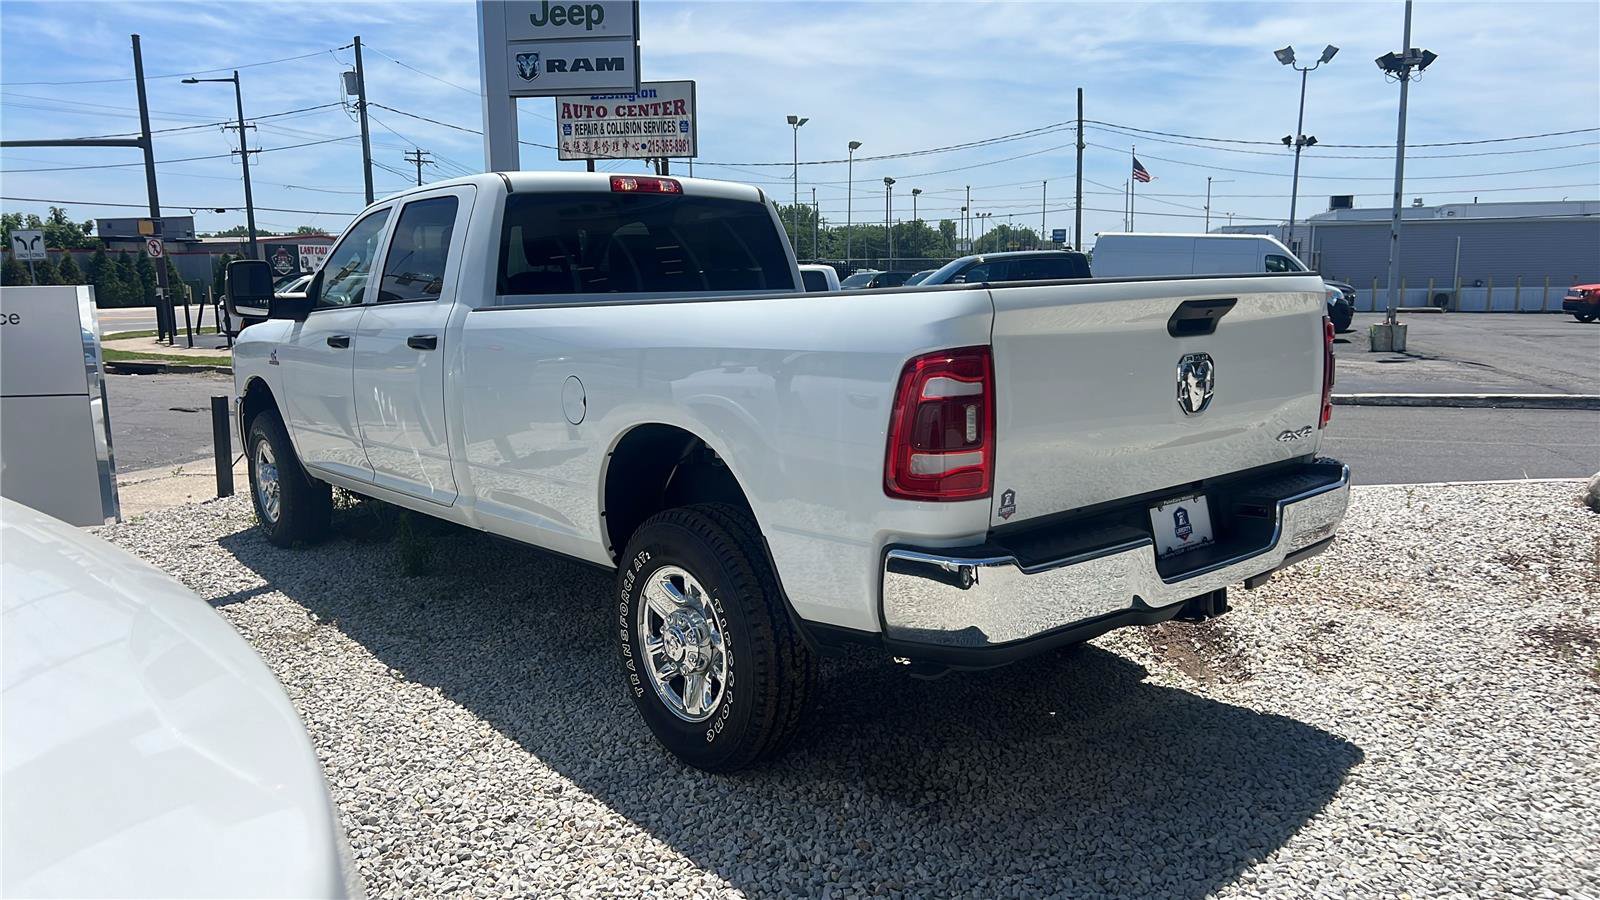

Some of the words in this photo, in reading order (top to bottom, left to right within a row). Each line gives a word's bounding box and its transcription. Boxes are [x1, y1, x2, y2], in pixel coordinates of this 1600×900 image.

[530, 0, 605, 31] Jeep
[546, 57, 624, 73] RAM
[561, 102, 608, 119] AUTO
[614, 99, 687, 117] CENTER
[575, 122, 599, 136] REPAIR
[600, 124, 605, 134] &
[606, 121, 642, 135] COLLISION
[643, 120, 676, 134] SERVICES
[300, 246, 314, 255] LAST
[617, 569, 645, 698] TRANSFORCE
